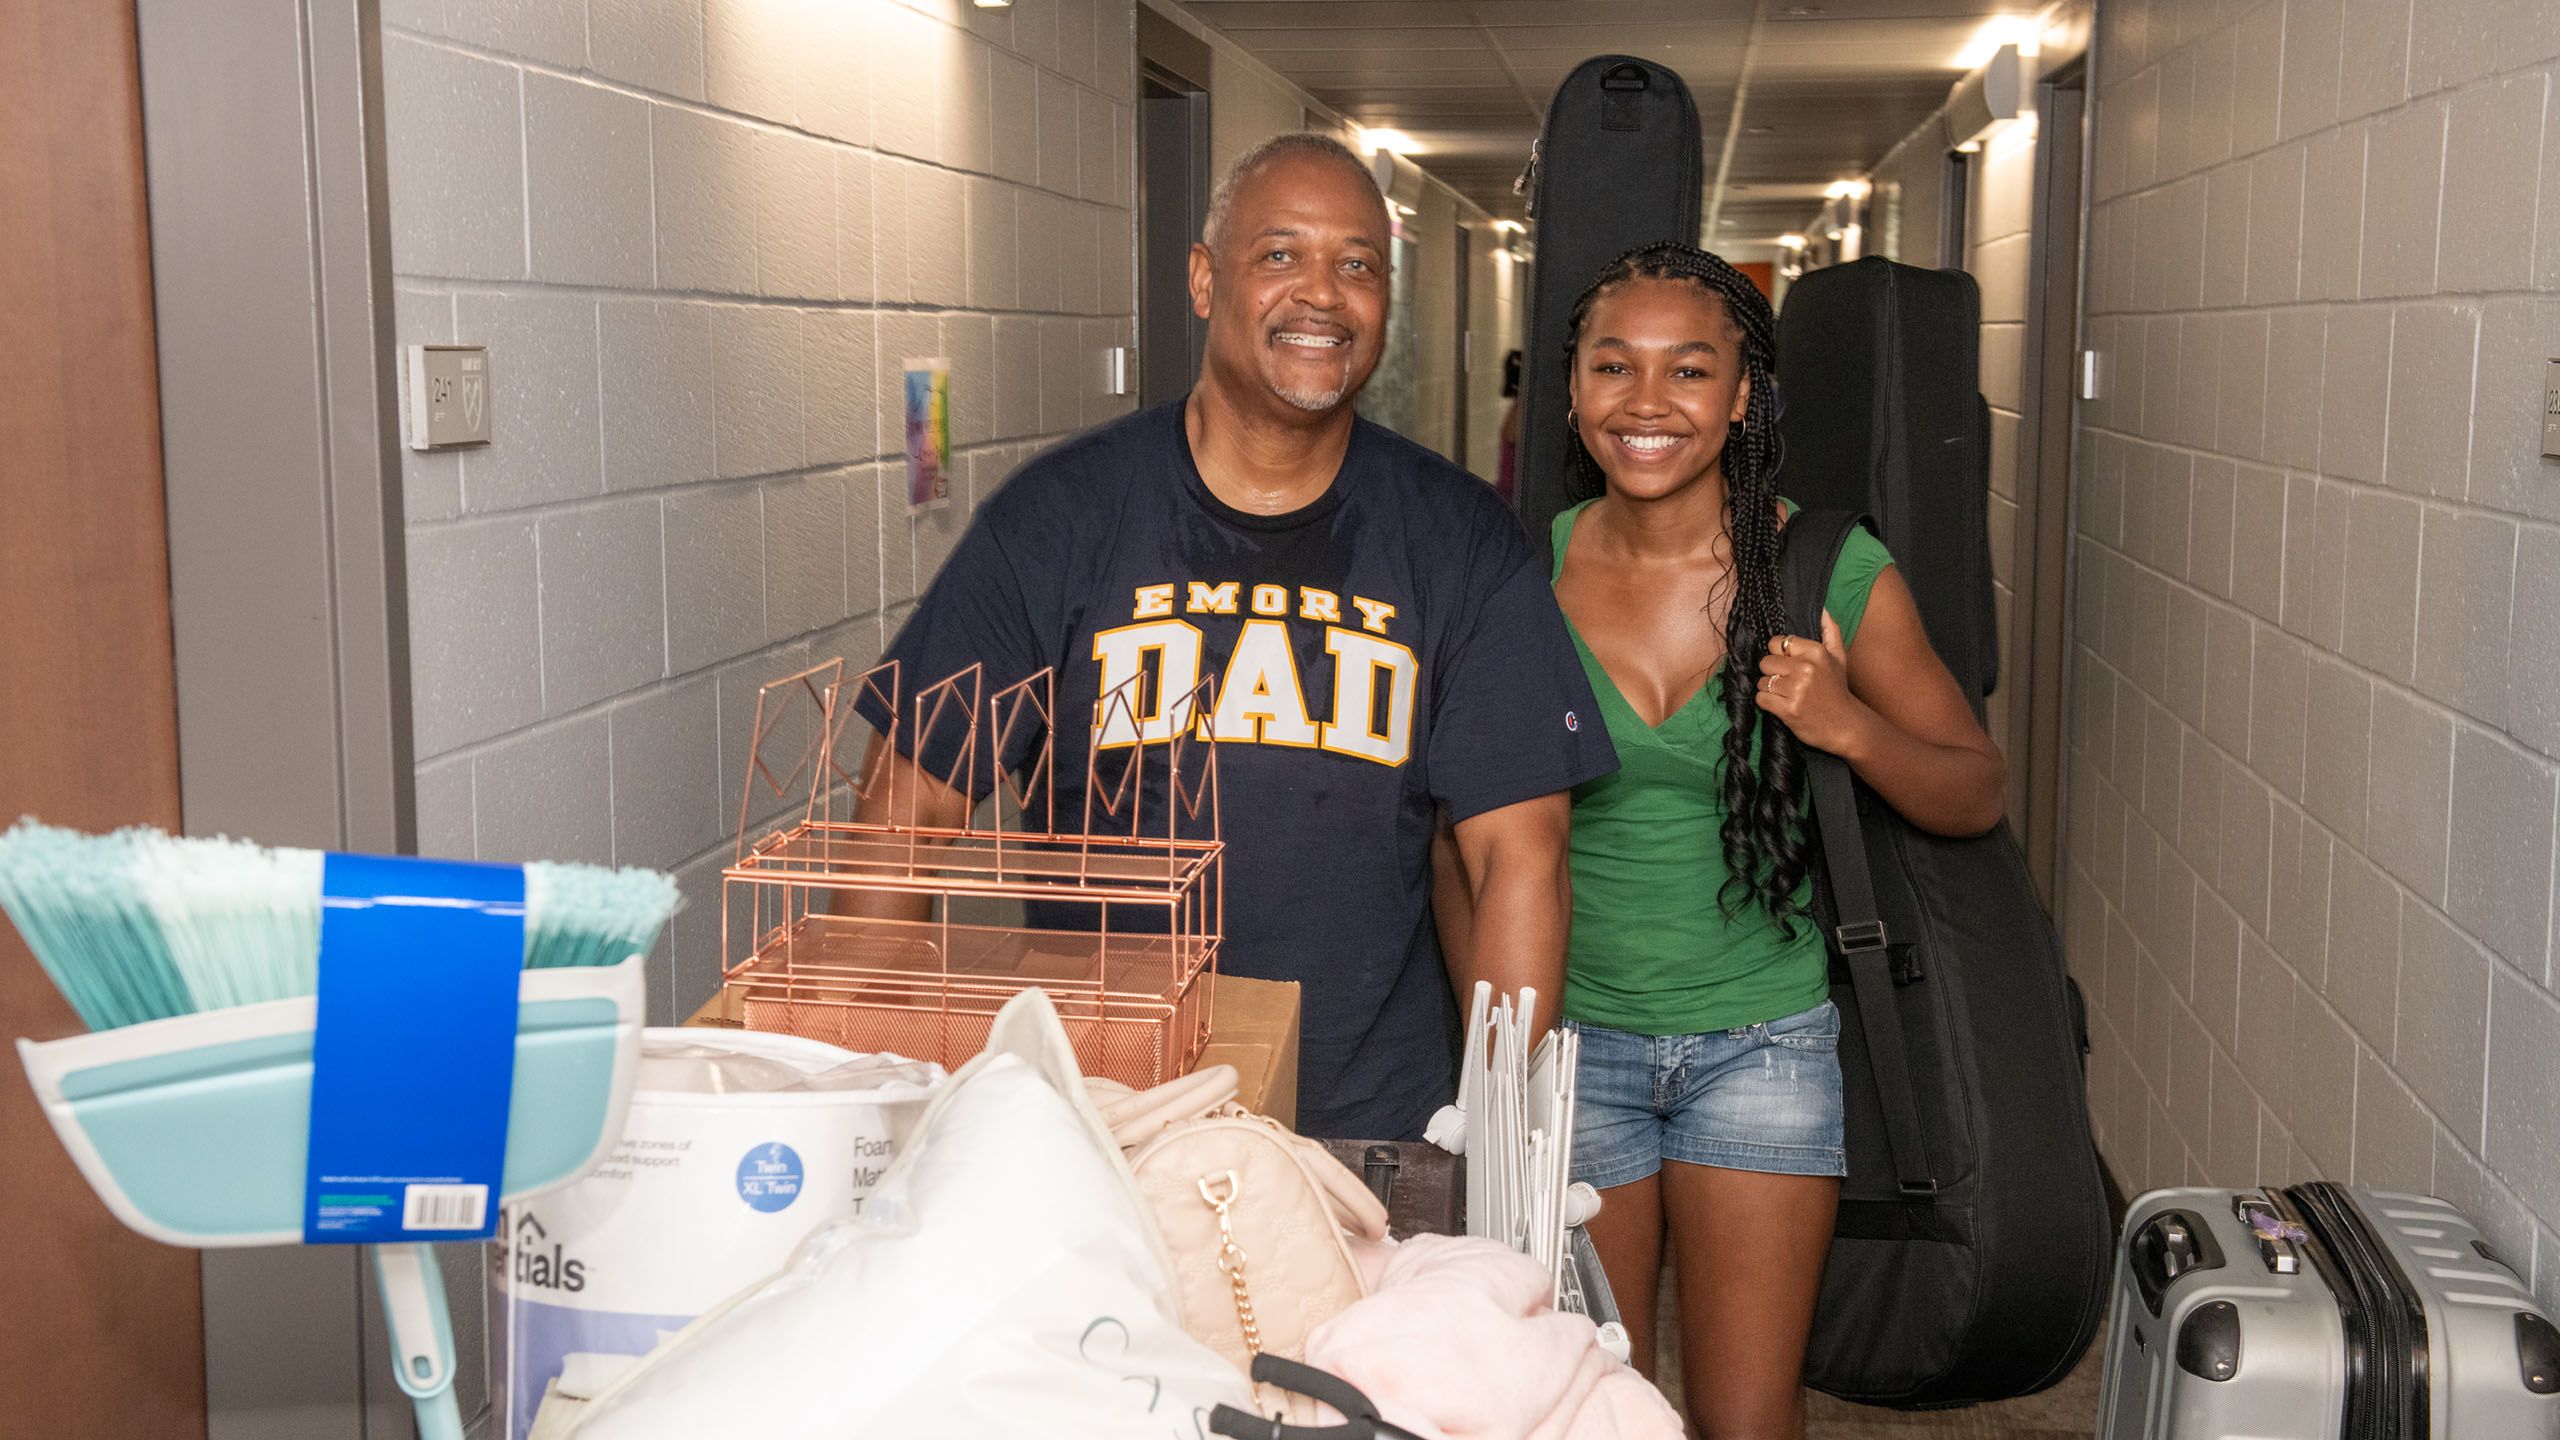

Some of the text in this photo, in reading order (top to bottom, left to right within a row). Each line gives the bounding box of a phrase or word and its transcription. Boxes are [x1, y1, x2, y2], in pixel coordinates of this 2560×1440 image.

[1133, 581, 1396, 634] EMORY
[1091, 618, 1419, 767] DAD
[678, 1139, 692, 1151] of
[631, 1156, 681, 1169] support
[754, 1160, 788, 1174] Twin
[742, 1181, 797, 1196] XL Twin
